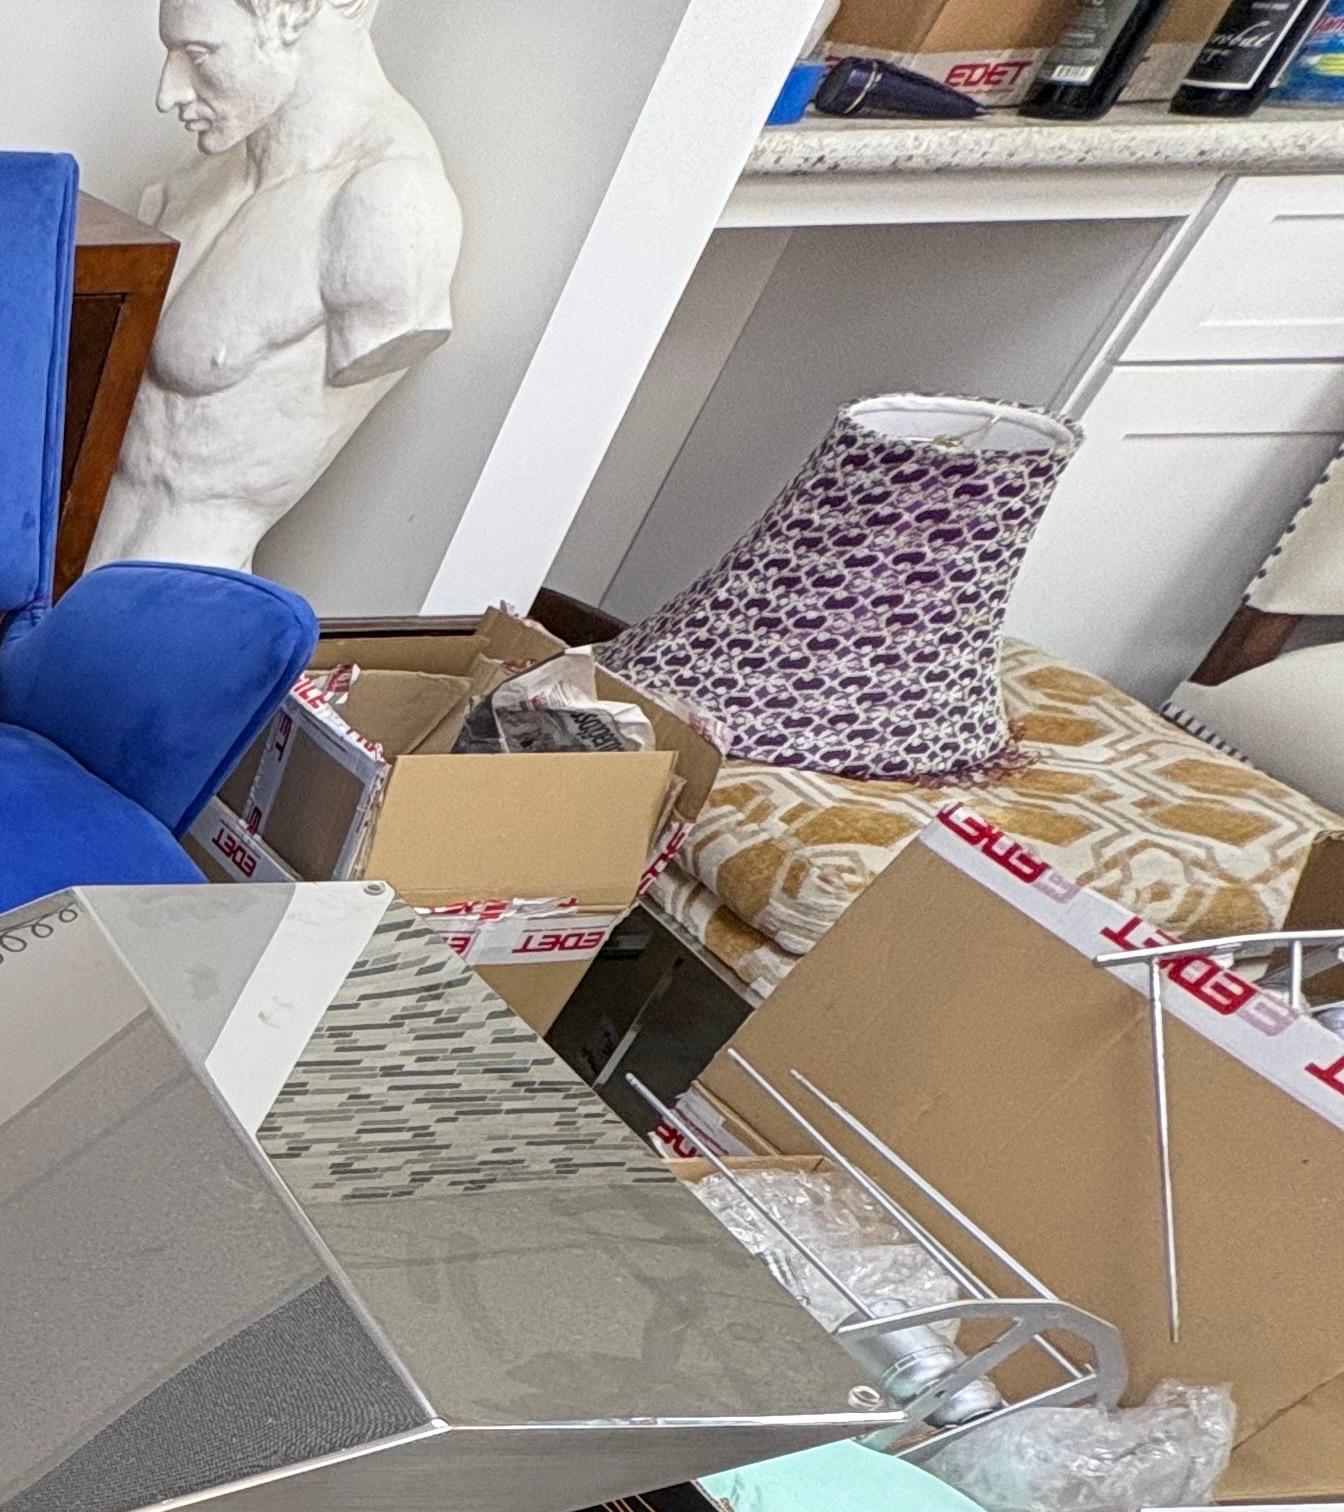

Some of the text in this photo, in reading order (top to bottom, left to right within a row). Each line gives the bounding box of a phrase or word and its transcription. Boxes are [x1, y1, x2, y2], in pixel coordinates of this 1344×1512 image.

[944, 61, 1032, 87] EDET
[212, 828, 257, 878] EDET
[512, 930, 606, 955] EDET
